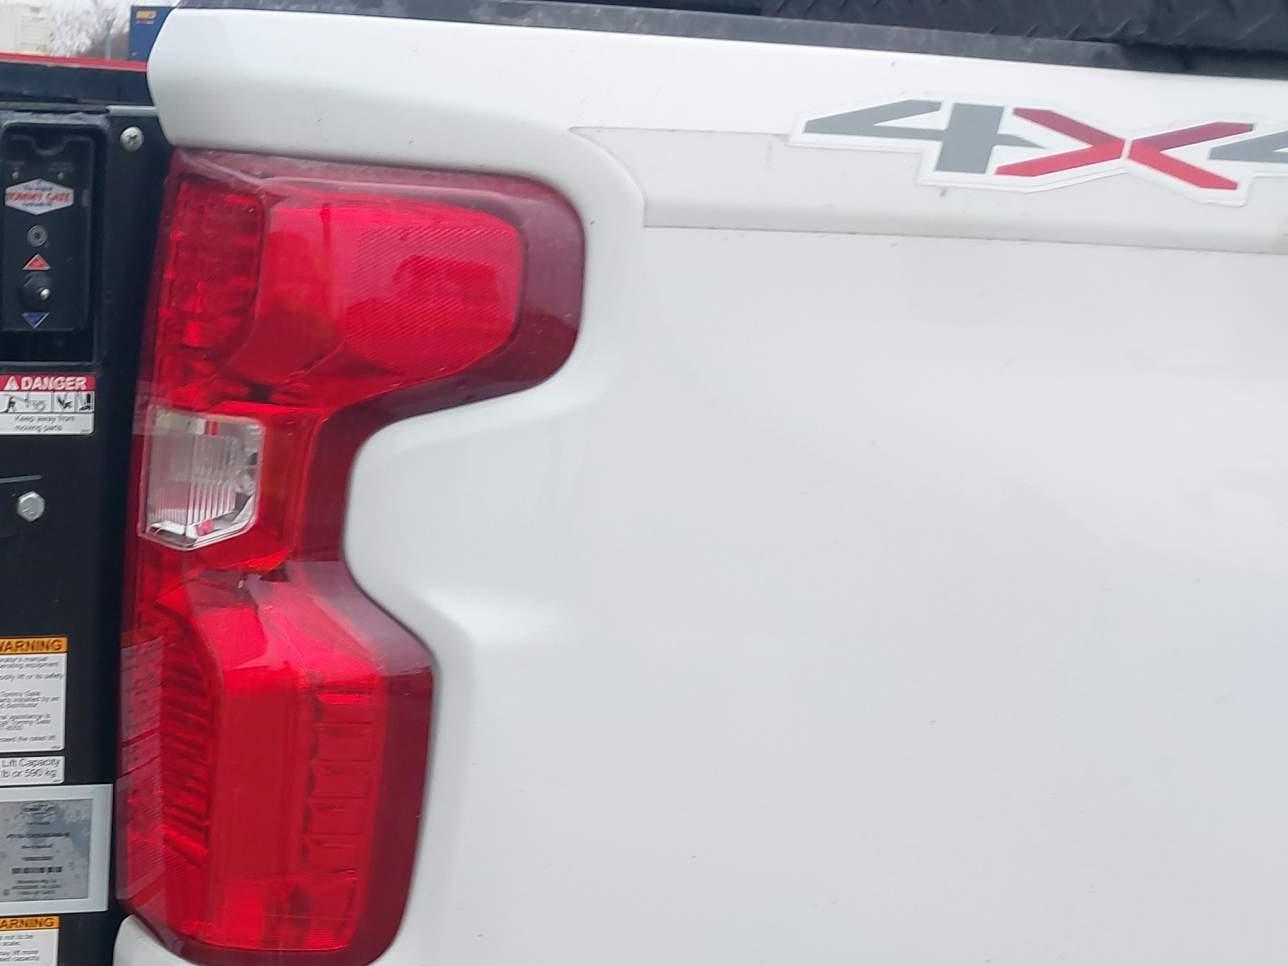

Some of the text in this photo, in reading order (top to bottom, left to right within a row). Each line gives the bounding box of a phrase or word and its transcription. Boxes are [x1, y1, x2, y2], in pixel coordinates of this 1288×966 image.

[20, 376, 87, 390] DANGER
[36, 416, 57, 424] away
[1, 758, 17, 768] Lift
[19, 757, 61, 769] Capacity
[2, 769, 11, 778] lb
[12, 770, 22, 778] or
[24, 768, 43, 778] 590
[44, 768, 57, 780] kg
